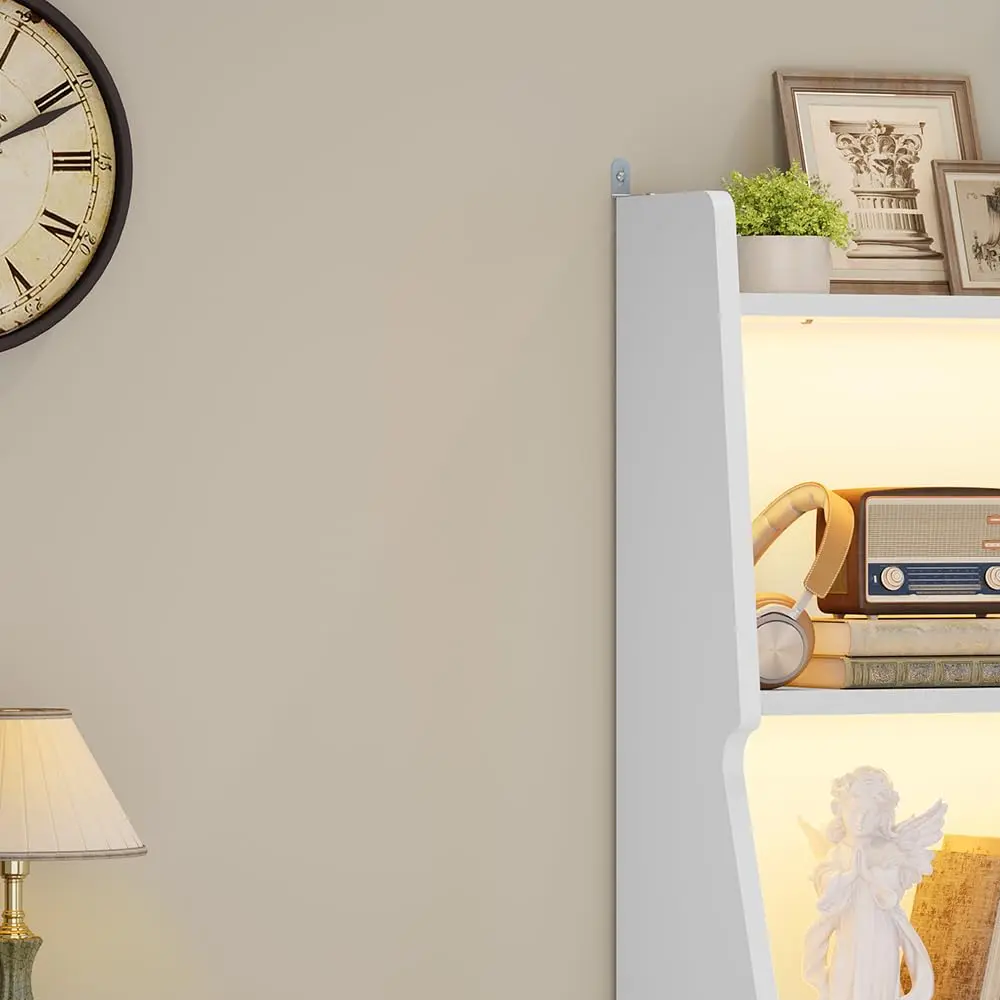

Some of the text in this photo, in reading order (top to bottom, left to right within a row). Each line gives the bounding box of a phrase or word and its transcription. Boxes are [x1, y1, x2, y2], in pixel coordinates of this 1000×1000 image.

[76, 70, 94, 90] 10
[34, 79, 75, 114] II
[52, 149, 93, 174] III
[98, 152, 112, 172] 15
[80, 231, 97, 256] 20
[4, 256, 33, 297] V
